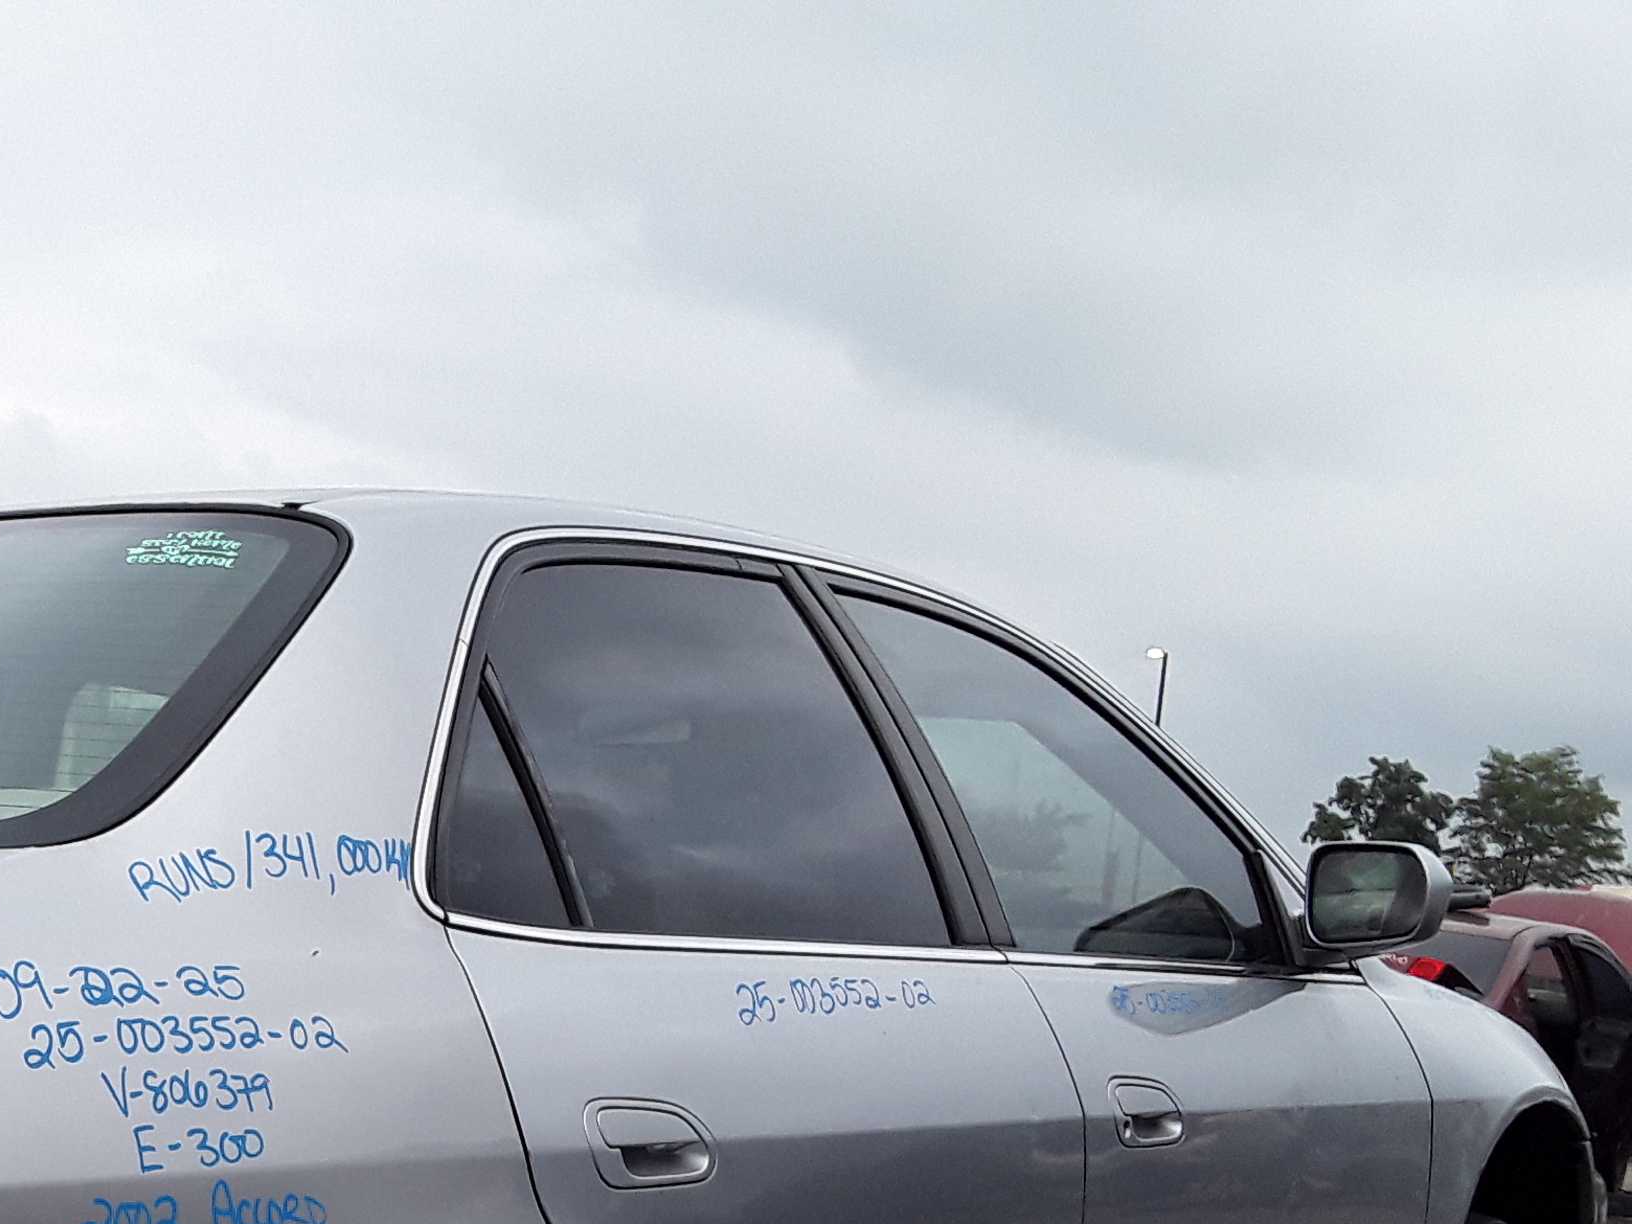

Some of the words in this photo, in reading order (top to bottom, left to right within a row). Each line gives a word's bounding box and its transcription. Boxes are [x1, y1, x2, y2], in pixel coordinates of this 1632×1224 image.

[23, 1015, 350, 1070] 25-003552-02
[101, 1066, 273, 1118] V-806379
[132, 1125, 265, 1174] E-300
